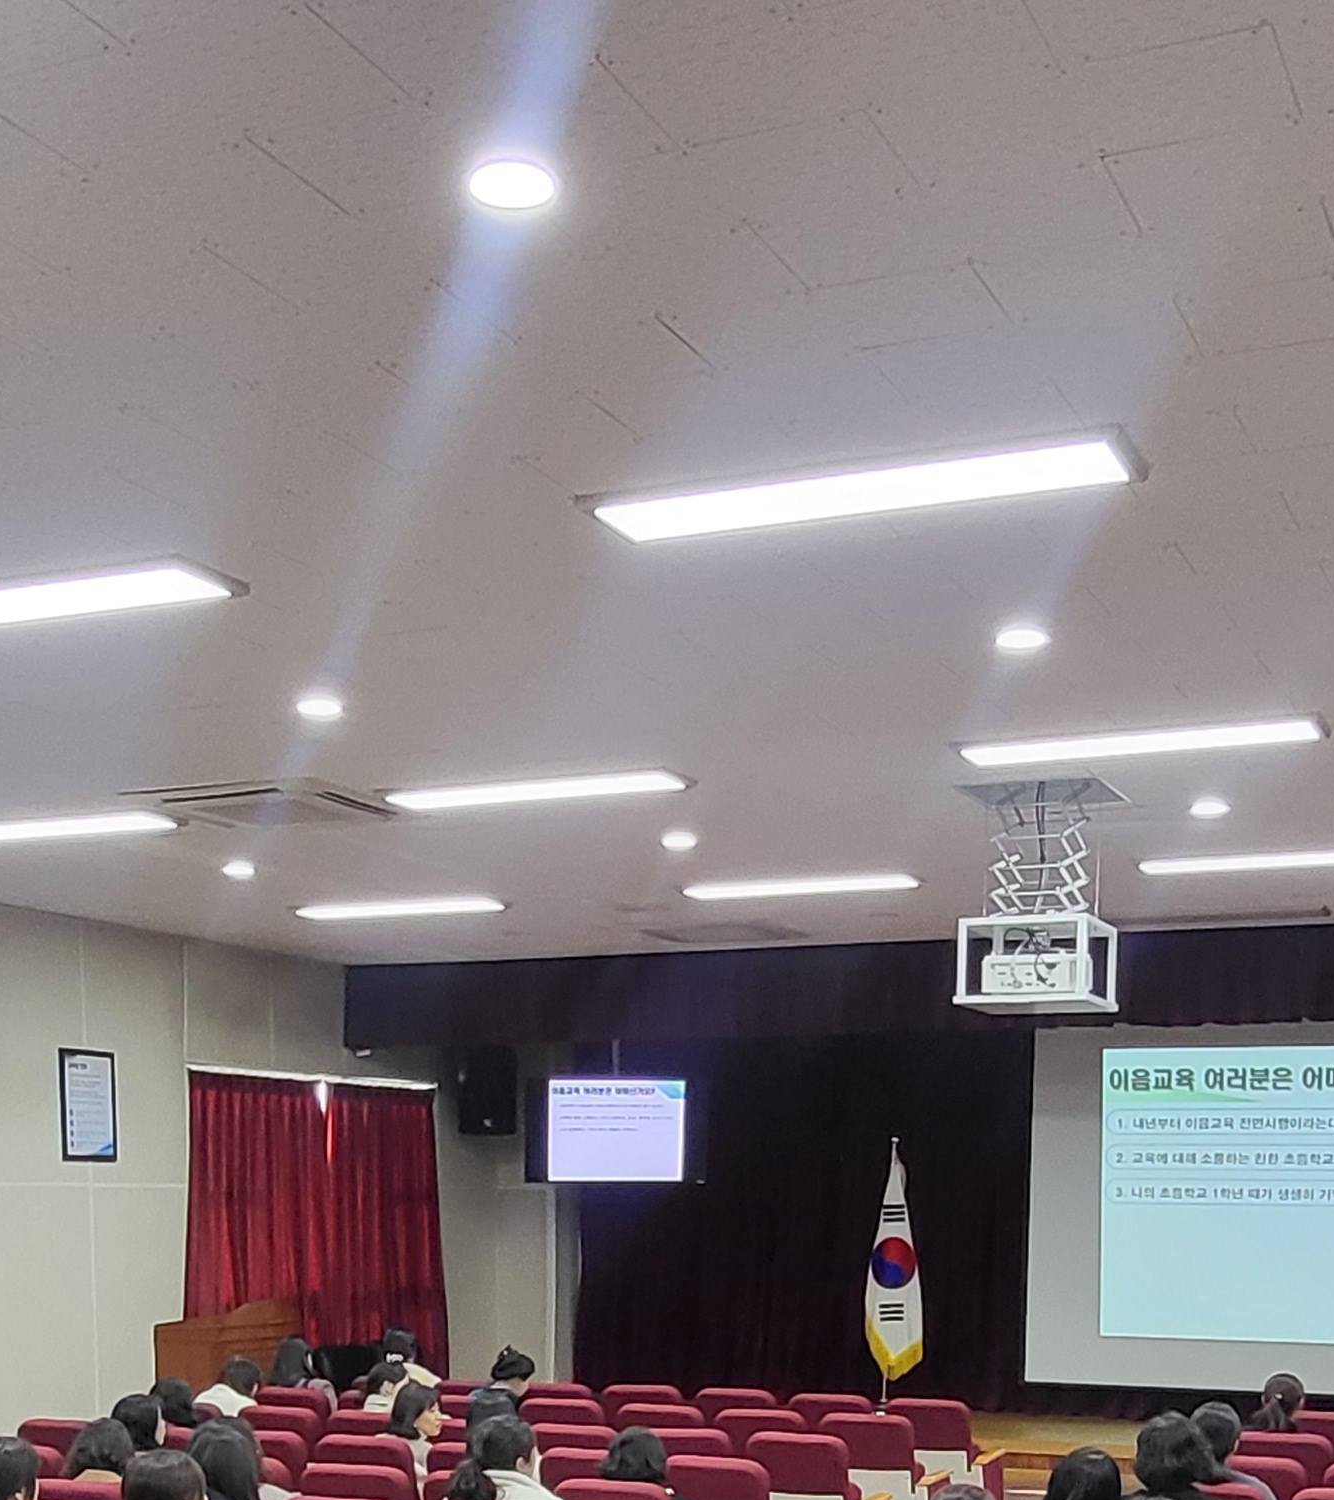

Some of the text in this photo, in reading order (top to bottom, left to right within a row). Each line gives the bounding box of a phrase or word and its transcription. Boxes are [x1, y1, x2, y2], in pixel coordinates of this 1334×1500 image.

[1109, 1067, 1196, 1092] 이음교육
[1204, 1066, 1294, 1092] 여러분은
[1117, 1118, 1128, 1130] 1.
[1132, 1117, 1181, 1130] 내년부터
[1185, 1117, 1234, 1130] 이음교육
[1116, 1152, 1128, 1164] 2.
[1131, 1152, 1168, 1165] 교육에
[1172, 1152, 1197, 1165] 대해
[1200, 1152, 1250, 1165] 소통하는
[1283, 1153, 1334, 1166] 초등학교
[1115, 1187, 1127, 1198] 3.
[1131, 1187, 1155, 1199] 나의
[1159, 1187, 1207, 1199] 초등학교
[1212, 1187, 1244, 1200] 1학년
[1277, 1188, 1314, 1201] 생생히
